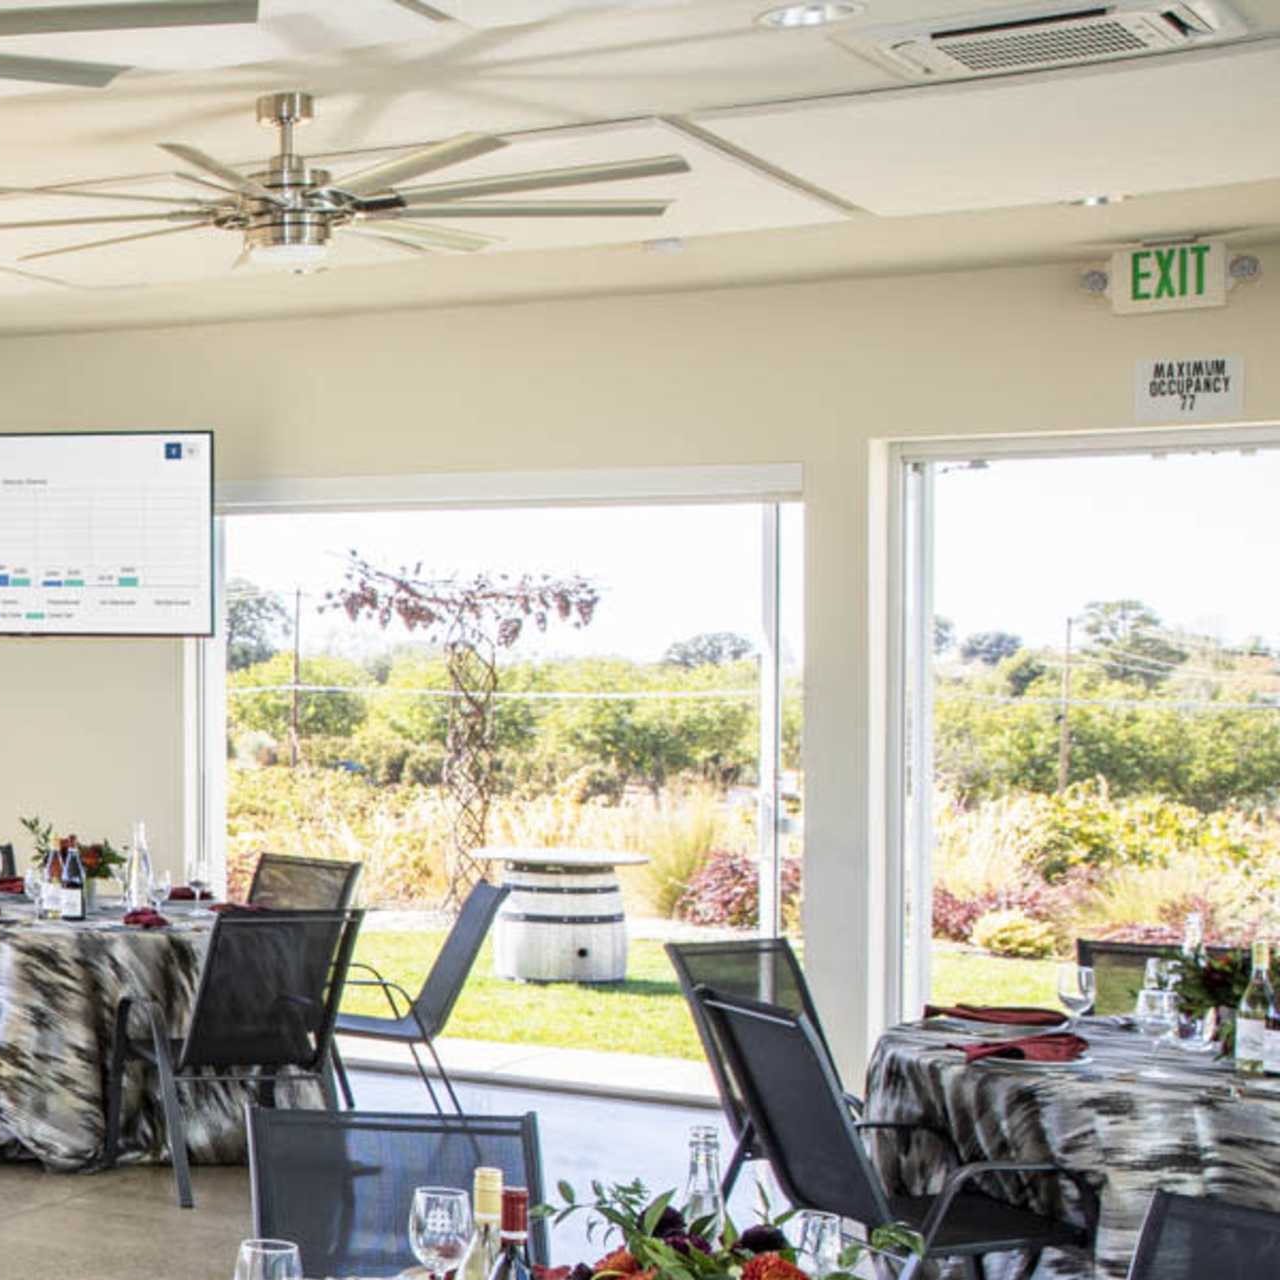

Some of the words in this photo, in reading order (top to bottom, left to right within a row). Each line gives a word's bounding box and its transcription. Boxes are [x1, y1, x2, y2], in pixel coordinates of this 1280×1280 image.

[1131, 245, 1210, 301] EXIT
[1153, 359, 1226, 379] MAXIMUM
[1149, 376, 1231, 397] OCCUPANCY
[1180, 395, 1196, 411] 77
